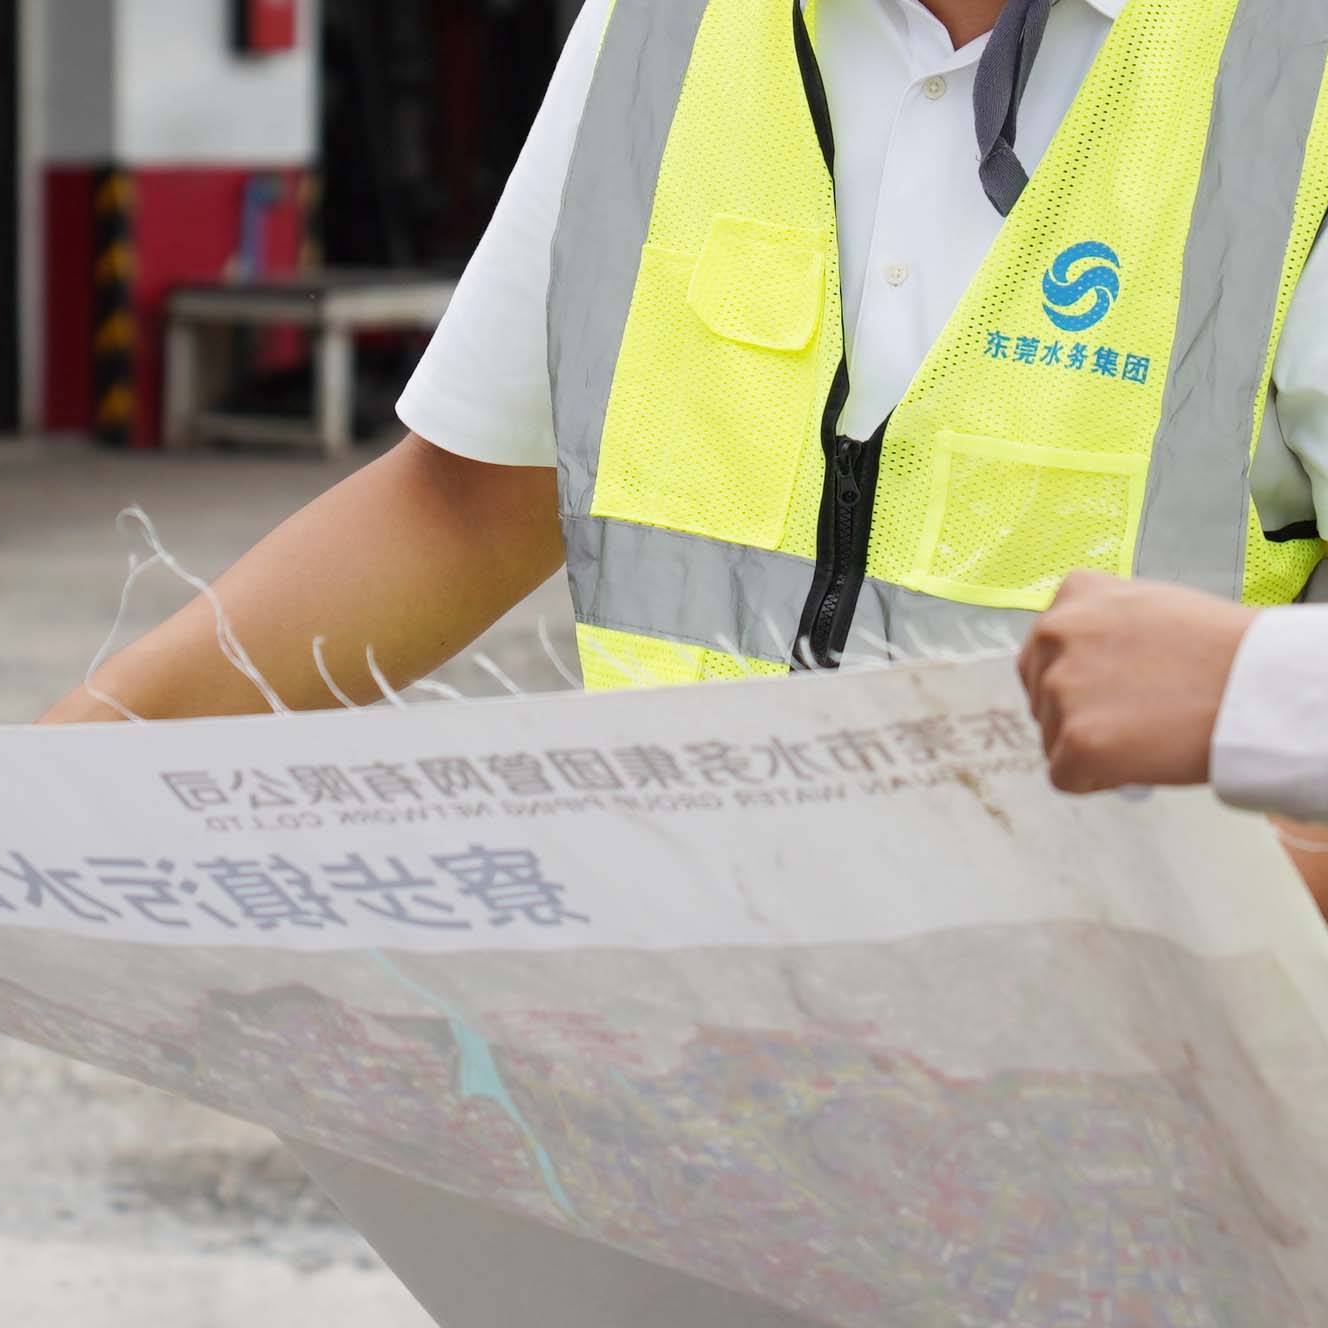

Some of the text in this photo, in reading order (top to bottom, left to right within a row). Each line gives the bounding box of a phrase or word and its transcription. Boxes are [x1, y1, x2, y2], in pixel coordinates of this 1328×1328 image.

[983, 329, 1152, 385] 东莞水务集团
